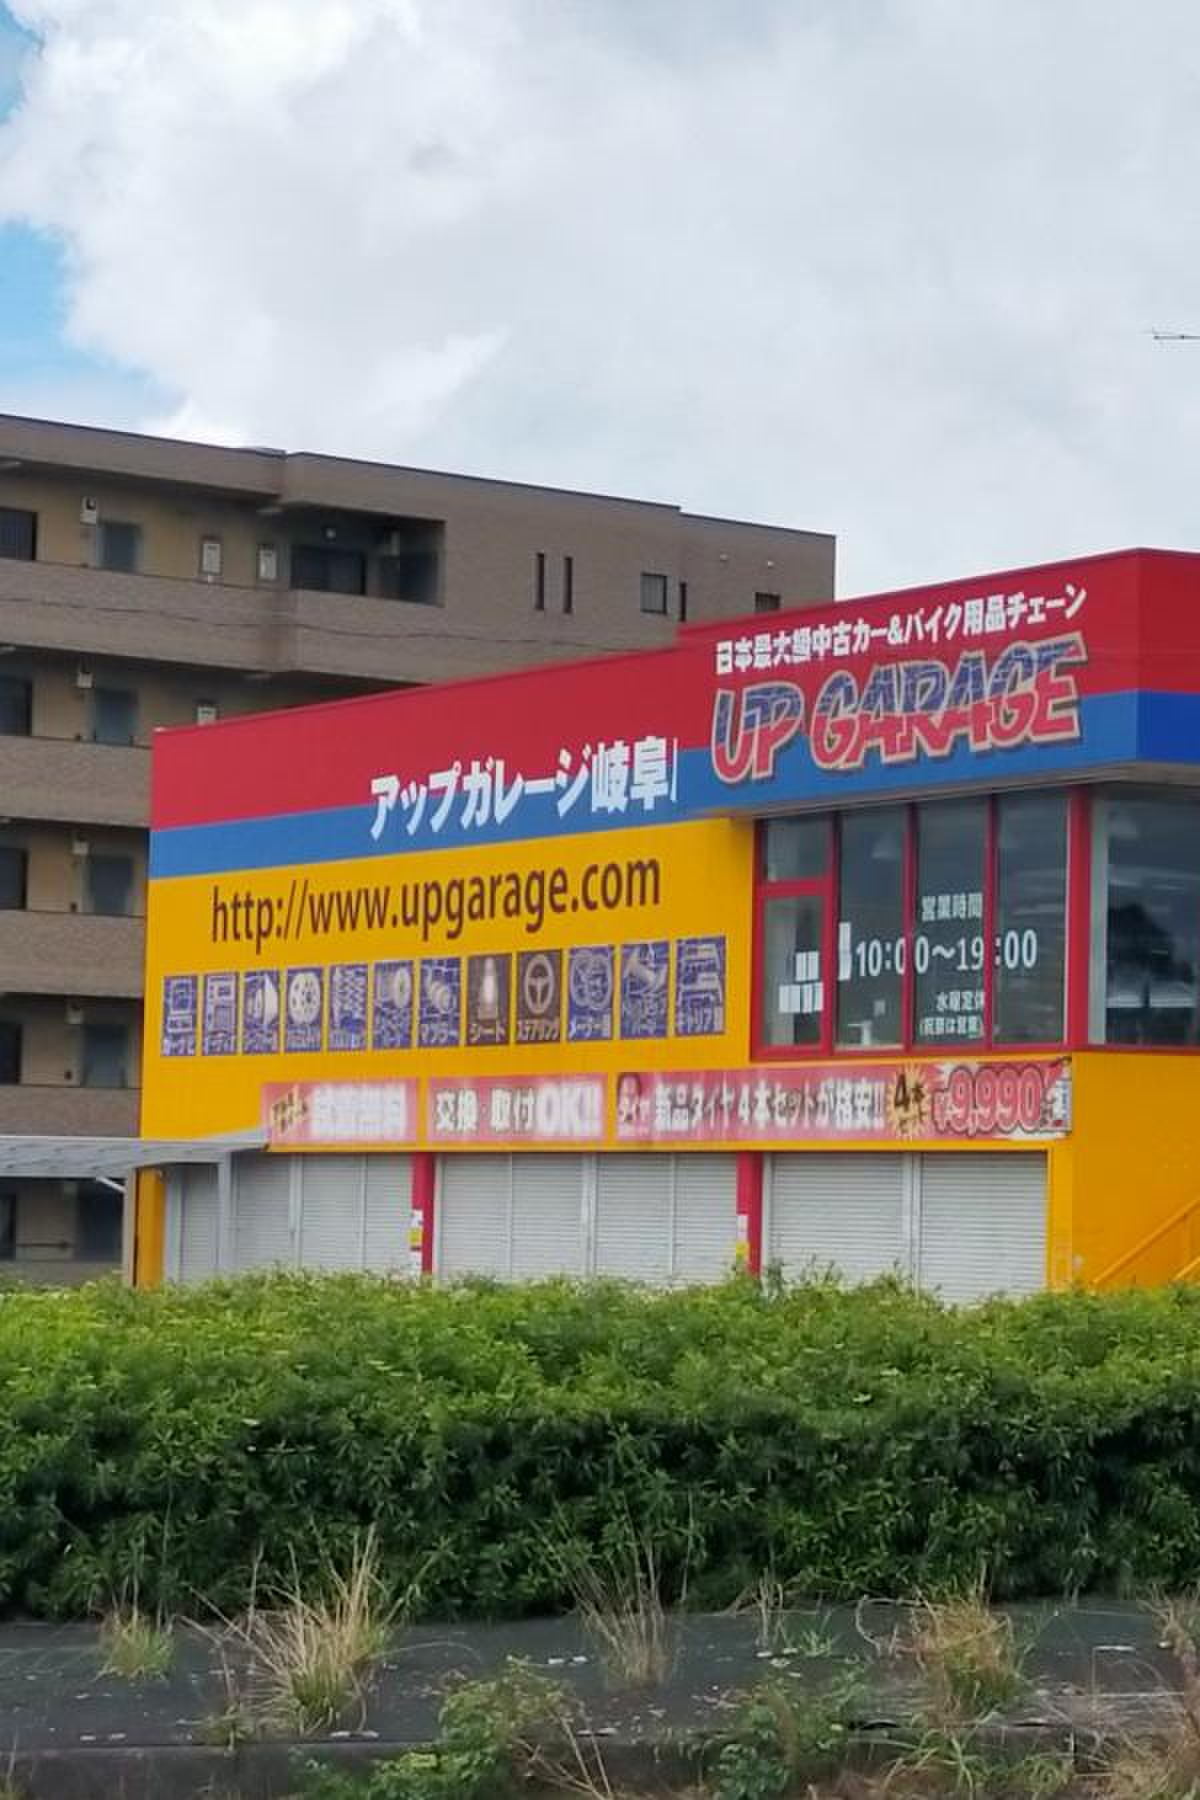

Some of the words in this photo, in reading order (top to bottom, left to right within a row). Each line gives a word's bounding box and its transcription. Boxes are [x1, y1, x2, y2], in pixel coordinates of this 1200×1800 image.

[712, 682, 804, 784] UP
[811, 632, 1089, 771] GARAGE
[369, 736, 678, 841] アップガレージ岐阜
[211, 857, 661, 955] http://www.upgarage.com
[469, 1022, 507, 1043] シート
